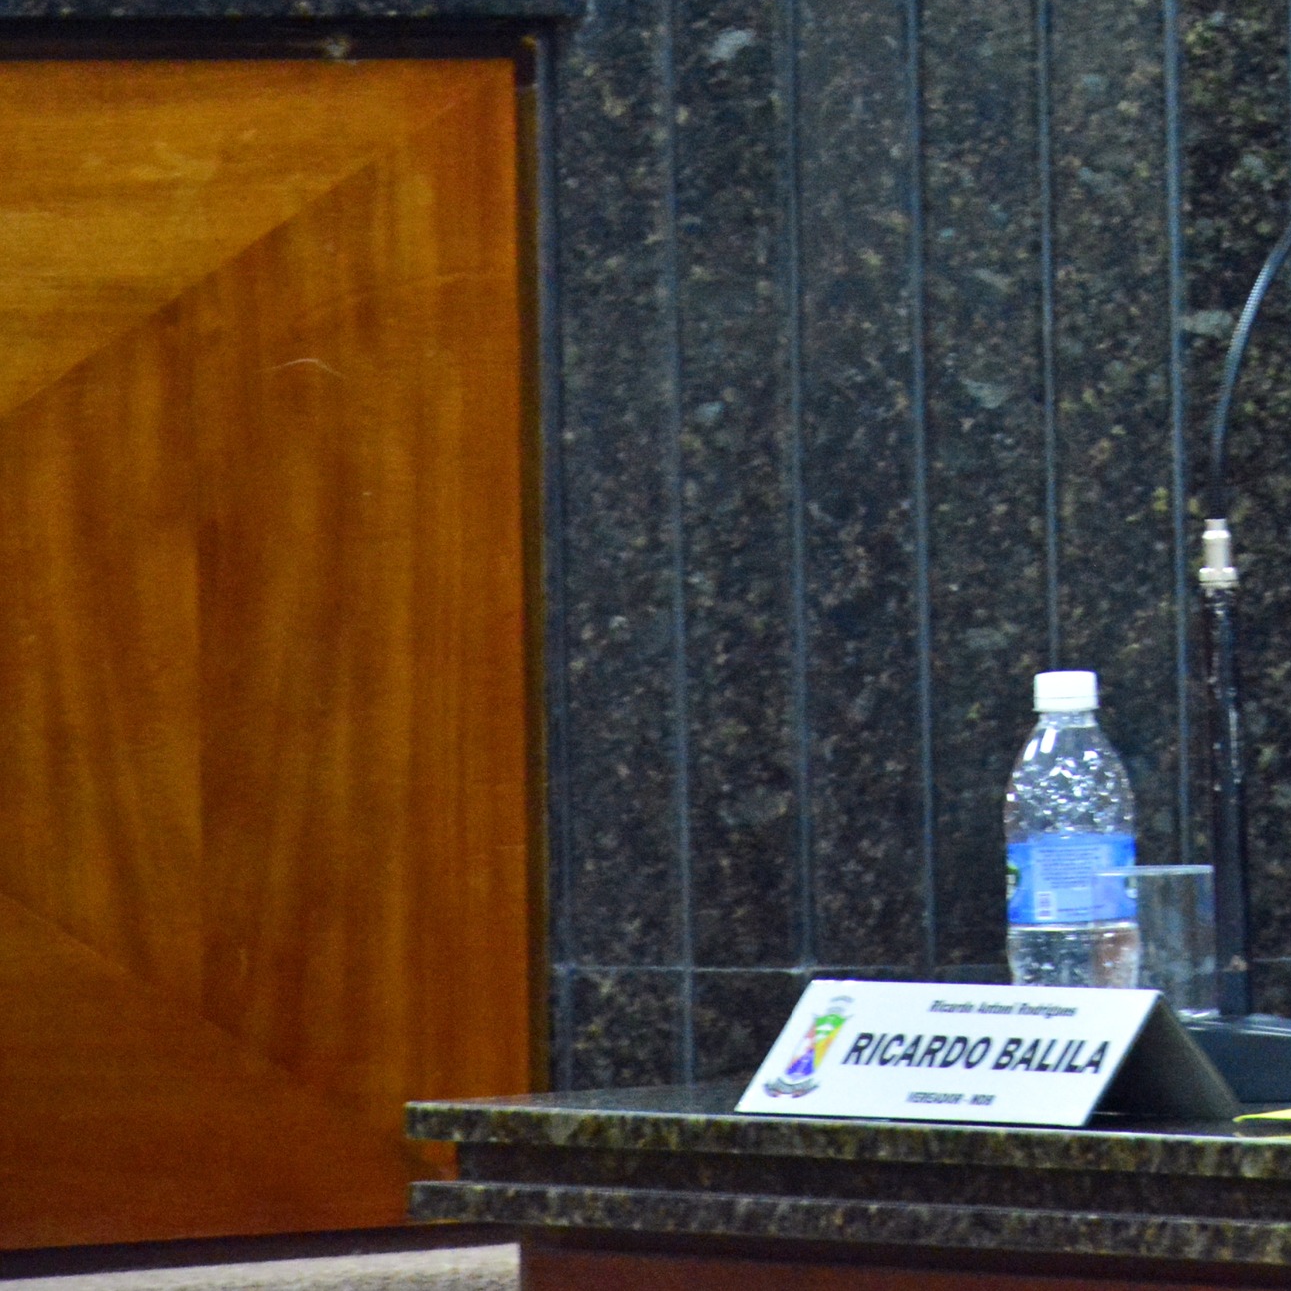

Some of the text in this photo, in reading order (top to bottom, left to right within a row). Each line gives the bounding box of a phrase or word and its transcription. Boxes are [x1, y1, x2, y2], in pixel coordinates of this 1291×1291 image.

[930, 999, 977, 1014] Ricardo
[1018, 1002, 1079, 1019] Rodrigues
[842, 1032, 1111, 1075] RICARDO BALILA
